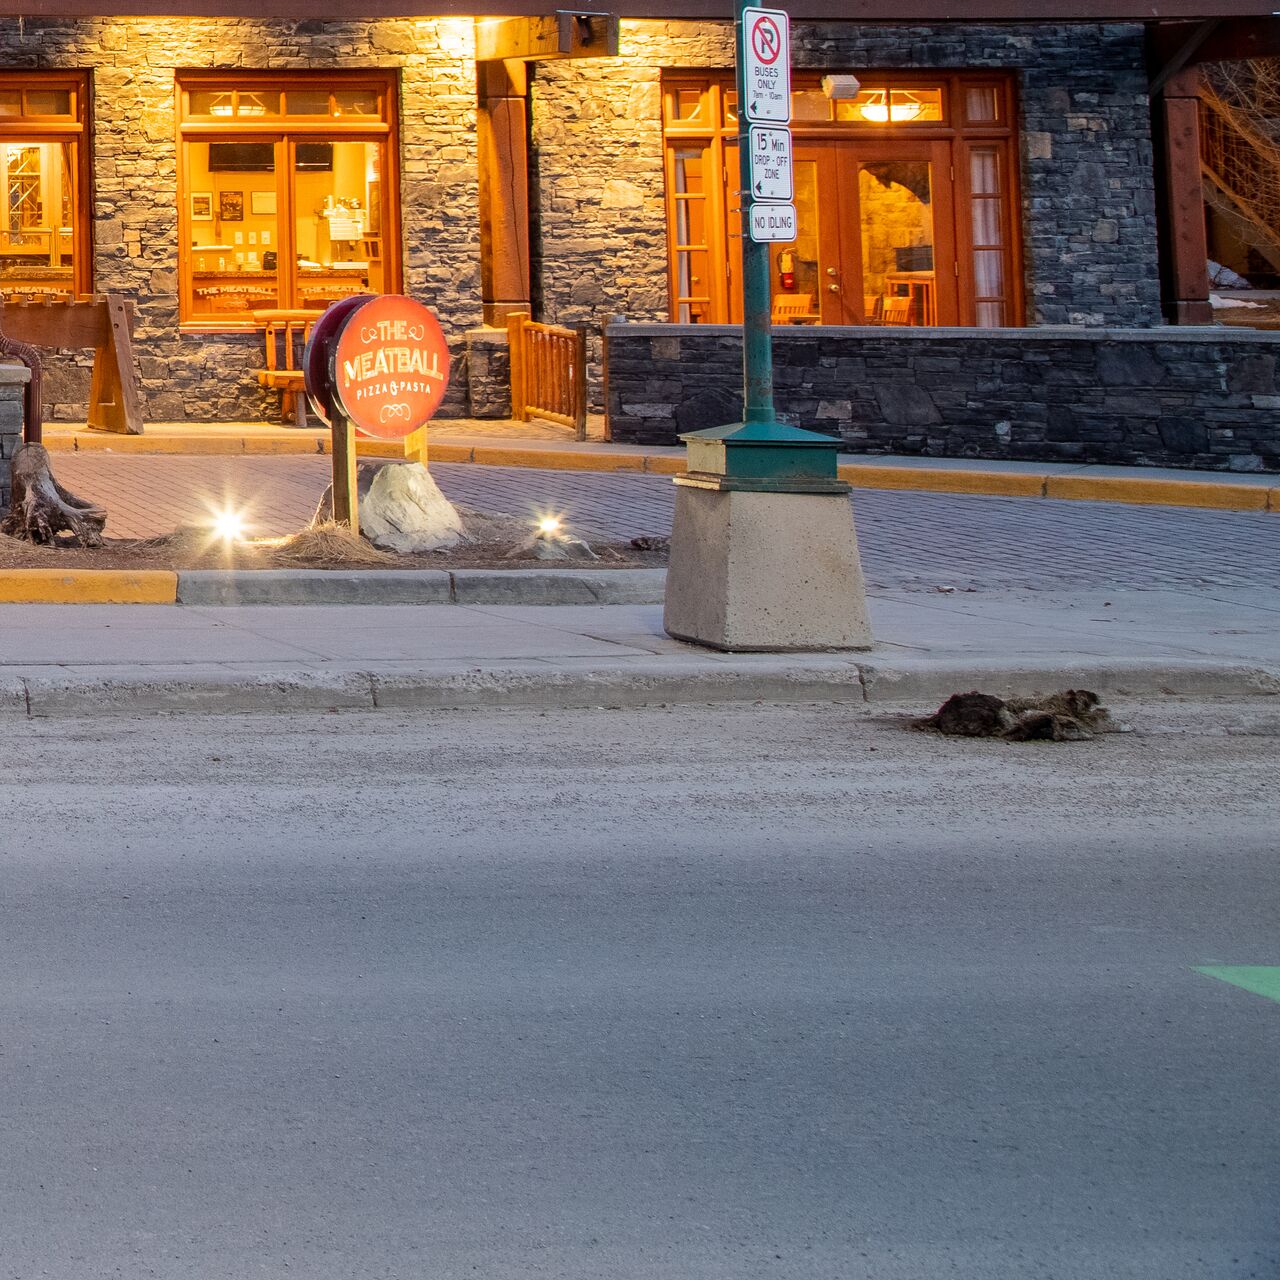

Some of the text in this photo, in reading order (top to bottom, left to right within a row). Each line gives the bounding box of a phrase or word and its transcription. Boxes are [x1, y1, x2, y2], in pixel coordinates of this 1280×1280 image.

[755, 66, 779, 78] BUSES
[757, 79, 776, 90] ONLY
[753, 89, 764, 99] 7am
[769, 91, 783, 100] 10am
[757, 132, 785, 151] 15 Min
[754, 154, 770, 166] DROP
[776, 155, 788, 167] OFF
[764, 168, 780, 180] ZONE
[754, 216, 792, 229] NO IDLING
[196, 285, 275, 296] THE MEATBALL
[376, 320, 408, 341] THE
[343, 347, 444, 388] MEATBALL
[356, 383, 388, 401] PIZZA
[400, 381, 431, 395] PASTA
